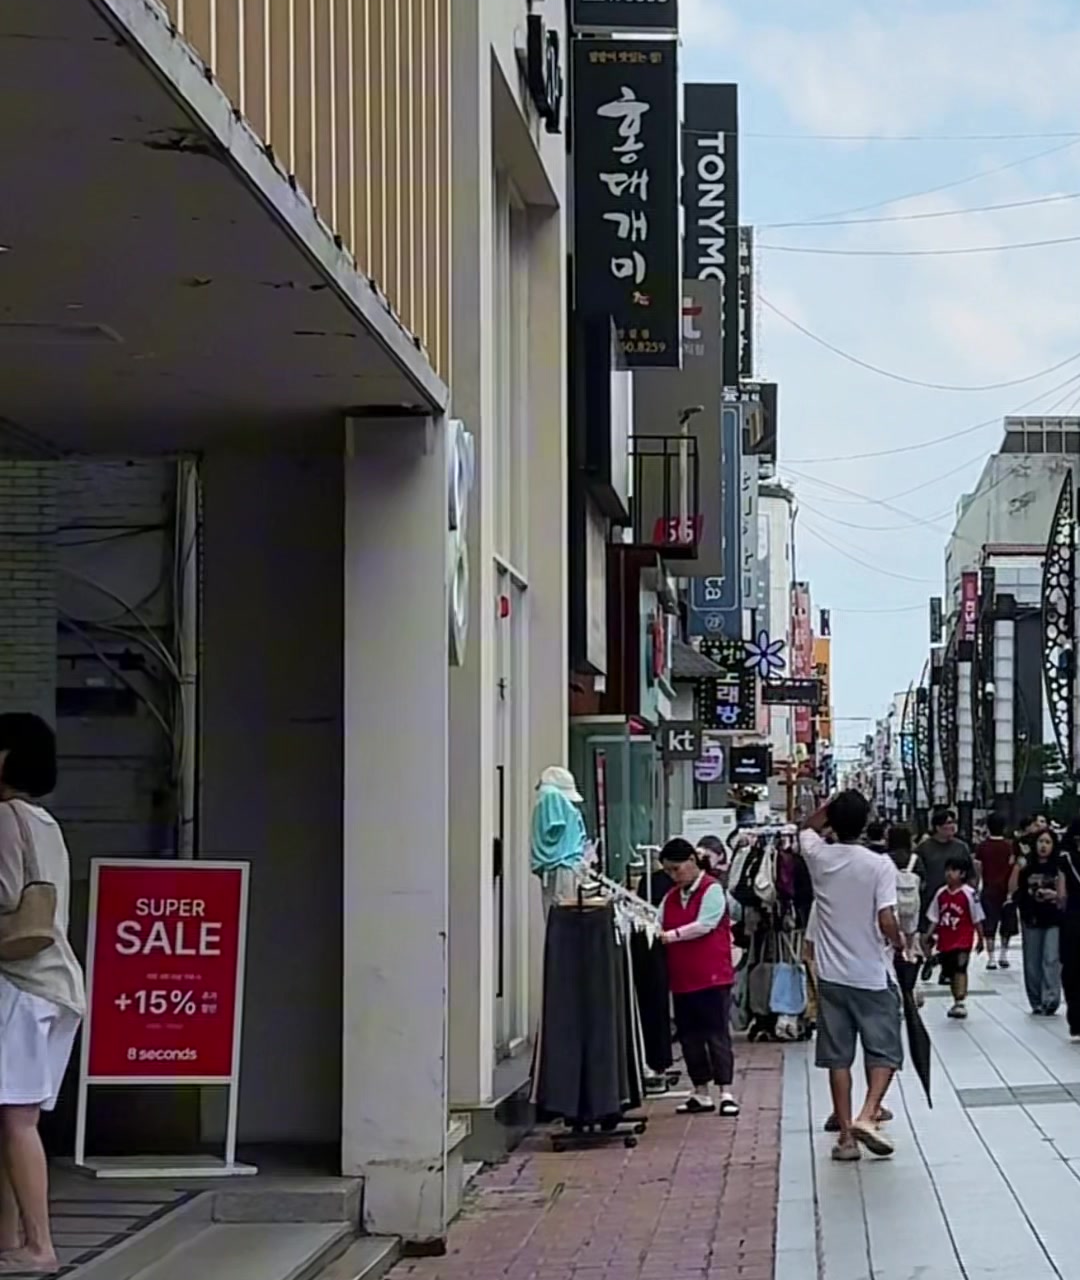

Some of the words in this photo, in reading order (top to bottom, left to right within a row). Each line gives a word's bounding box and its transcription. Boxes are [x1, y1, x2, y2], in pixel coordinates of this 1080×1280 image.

[596, 85, 651, 285] 홍대개미
[715, 672, 742, 724] 노래방
[668, 730, 695, 751] kt
[135, 898, 205, 917] SUPER
[115, 920, 223, 956] SALE
[114, 989, 197, 1015] +15%
[127, 1047, 137, 1060] 8
[138, 1047, 198, 1061] seconds
